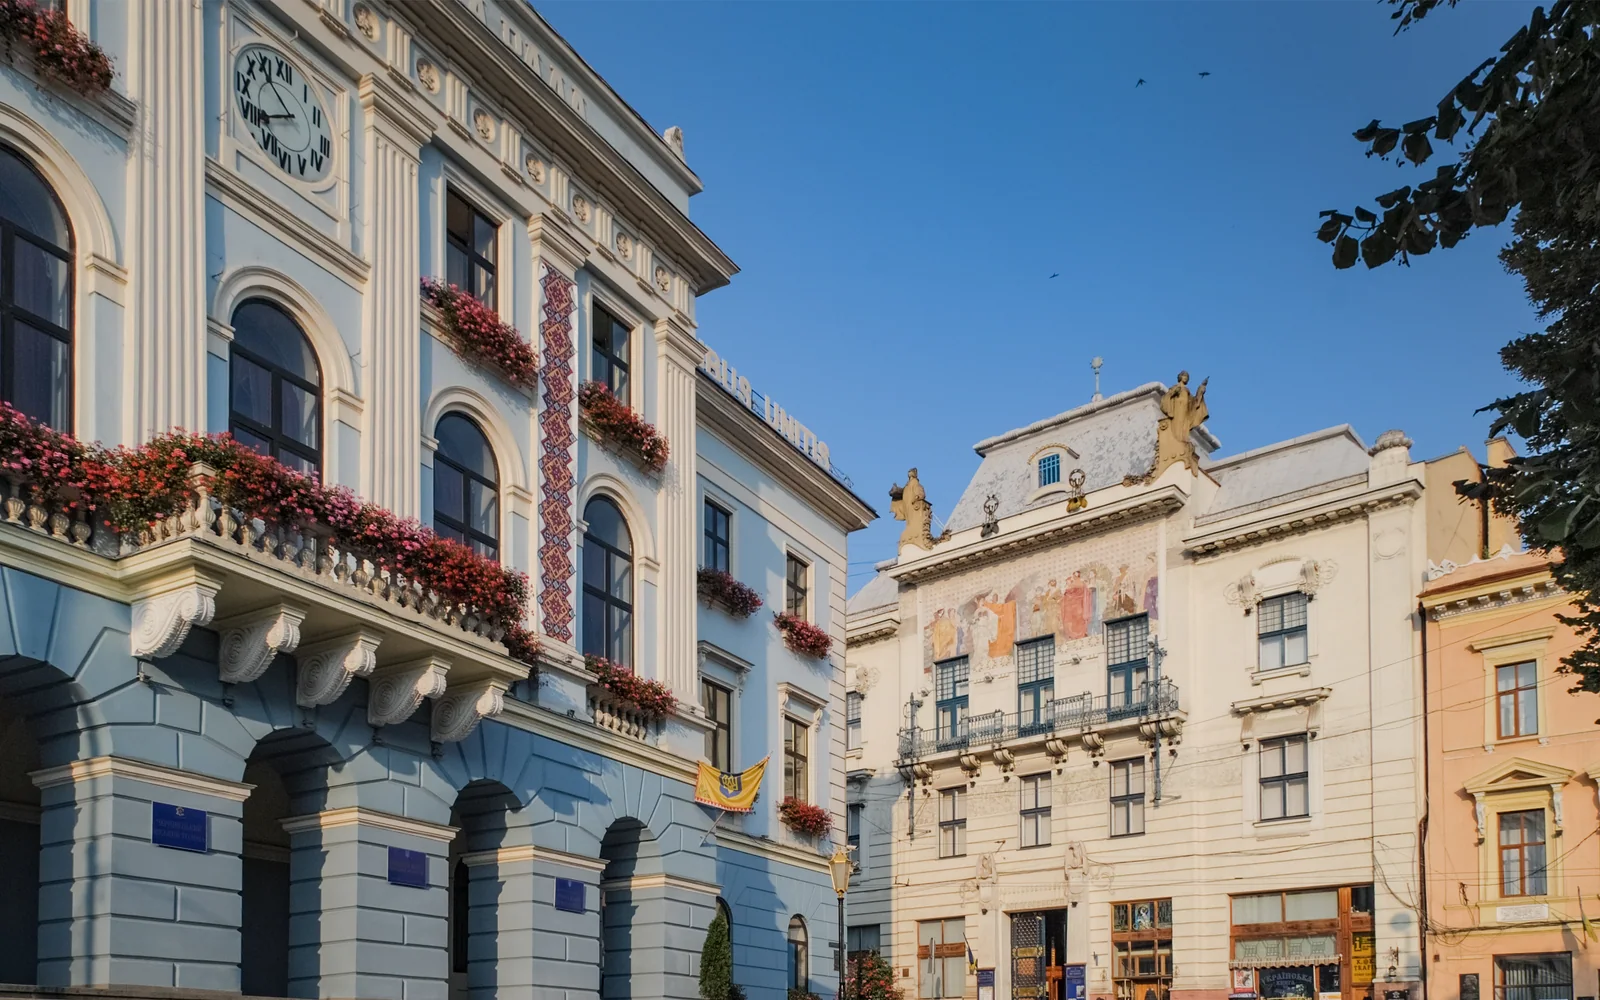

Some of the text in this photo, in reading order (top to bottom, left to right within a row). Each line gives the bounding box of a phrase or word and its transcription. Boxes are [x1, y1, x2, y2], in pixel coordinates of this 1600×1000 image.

[246, 55, 256, 80] X
[258, 51, 272, 80] XI
[275, 56, 292, 86] XII
[237, 71, 251, 99] IX
[241, 96, 262, 128] VIII
[313, 106, 320, 128] II
[262, 128, 277, 157] VII
[320, 135, 330, 158] III
[278, 147, 291, 174] VI
[297, 154, 306, 176] V
[310, 148, 323, 172] IV
[765, 393, 830, 470] UNITIS
